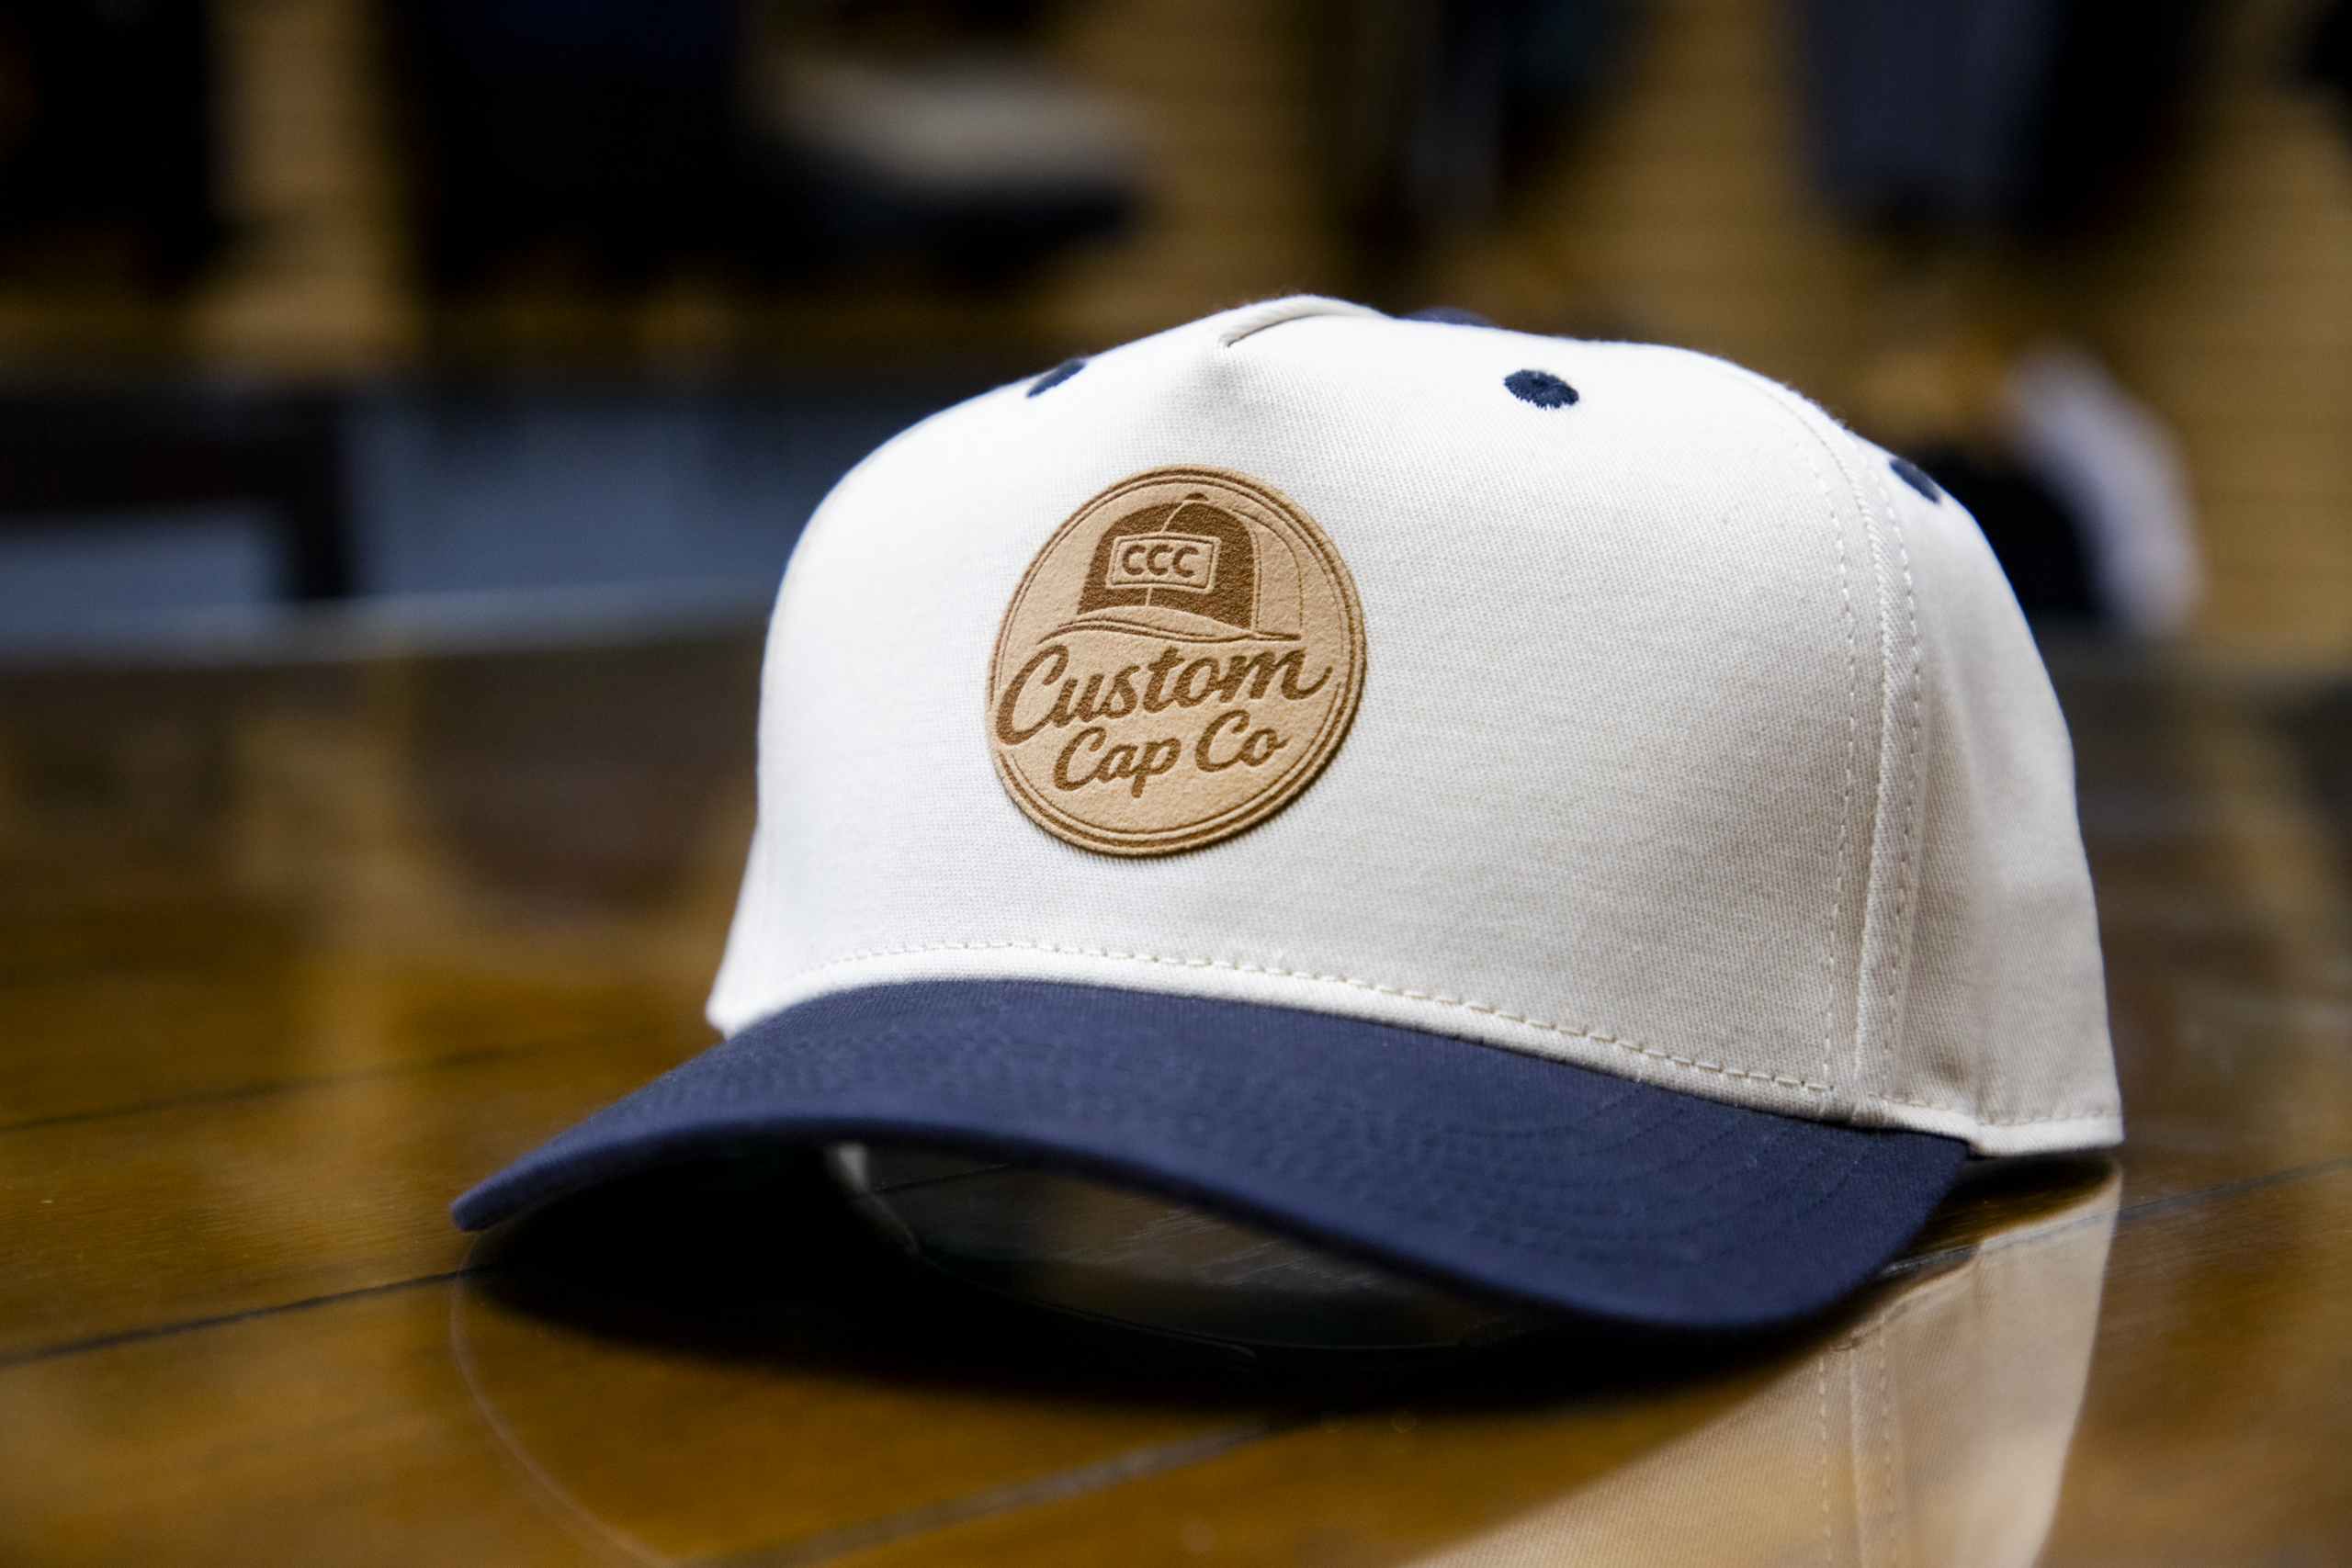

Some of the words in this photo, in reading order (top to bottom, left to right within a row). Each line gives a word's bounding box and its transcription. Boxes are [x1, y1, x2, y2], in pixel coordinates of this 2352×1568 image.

[1122, 544, 1200, 578] CCC
[996, 644, 1333, 745] Custom
[1052, 726, 1182, 799] Cap
[1195, 709, 1289, 773] Co
